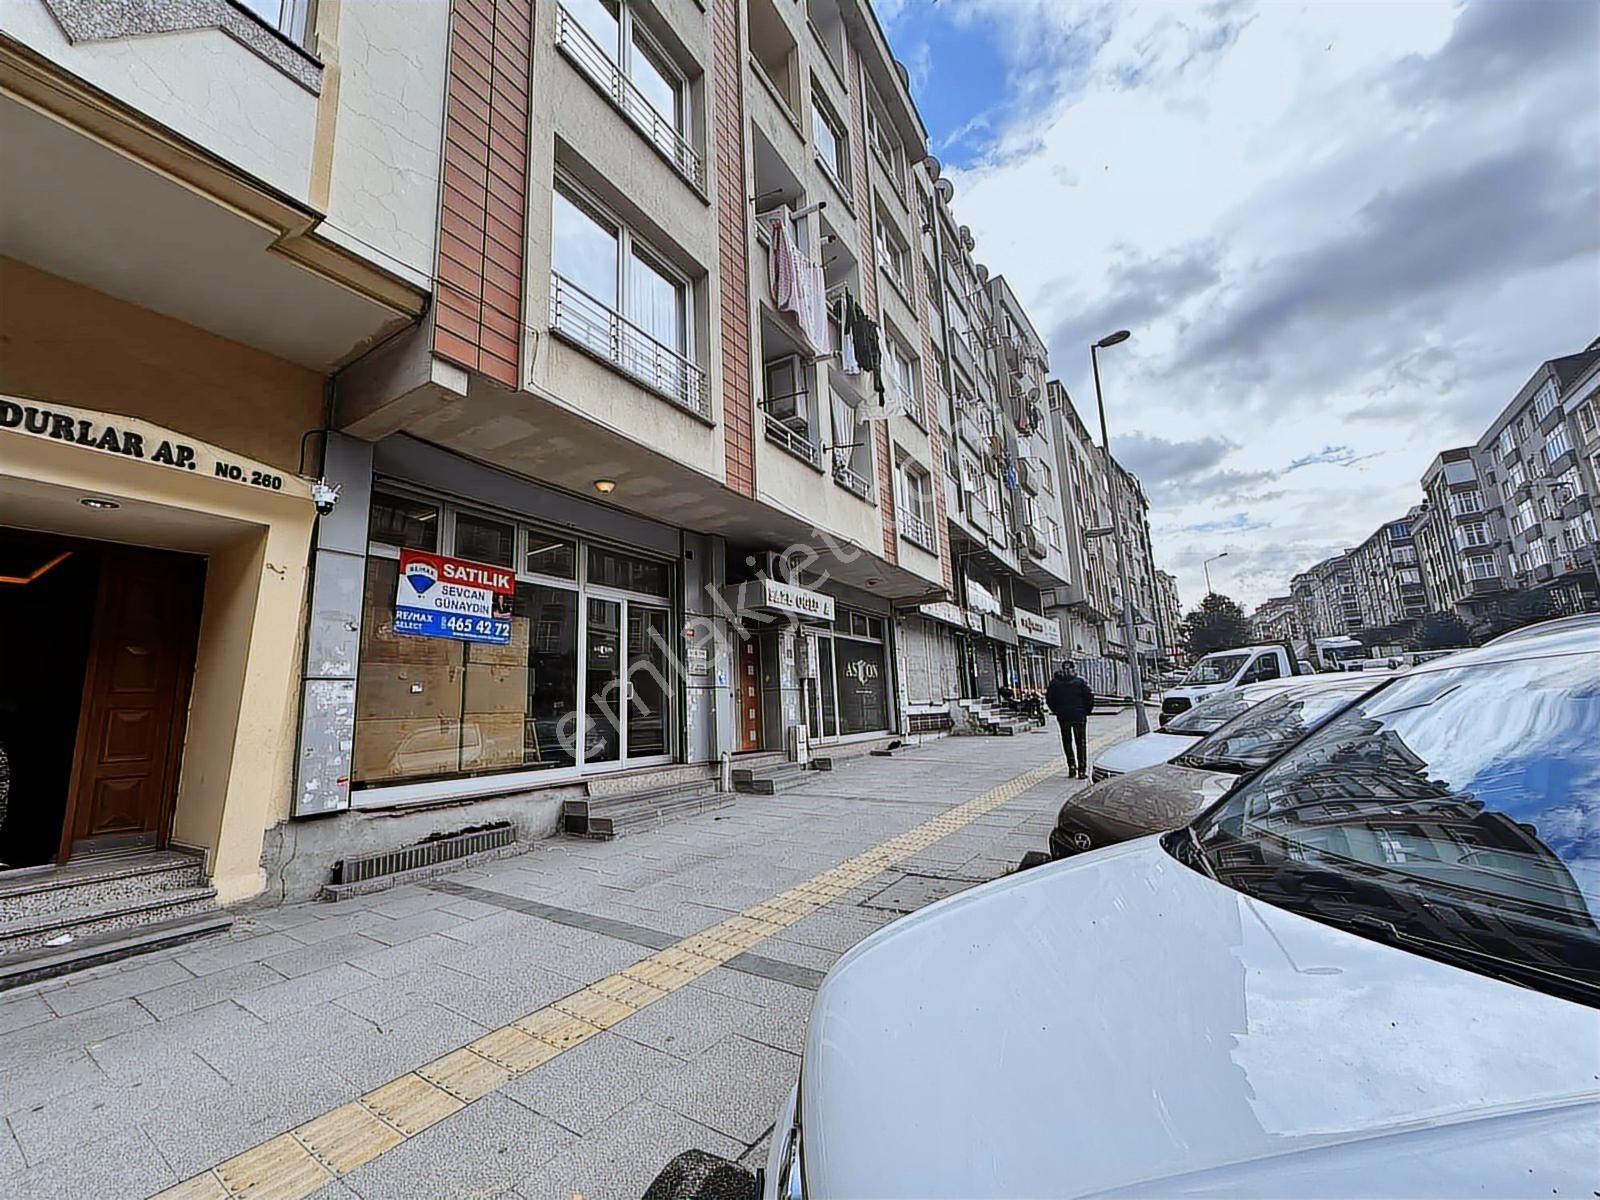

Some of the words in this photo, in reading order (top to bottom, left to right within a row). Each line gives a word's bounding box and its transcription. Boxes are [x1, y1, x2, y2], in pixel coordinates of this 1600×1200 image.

[151, 440, 196, 470] AP.
[215, 461, 247, 482] NO.
[251, 471, 282, 490] 260
[442, 563, 510, 588] SATILIK
[441, 585, 485, 601] SEVCAN
[395, 621, 423, 630] SELECT
[396, 610, 433, 623] RE/MAX
[447, 616, 473, 632] 465
[476, 620, 492, 635] 42
[494, 622, 510, 637] 72
